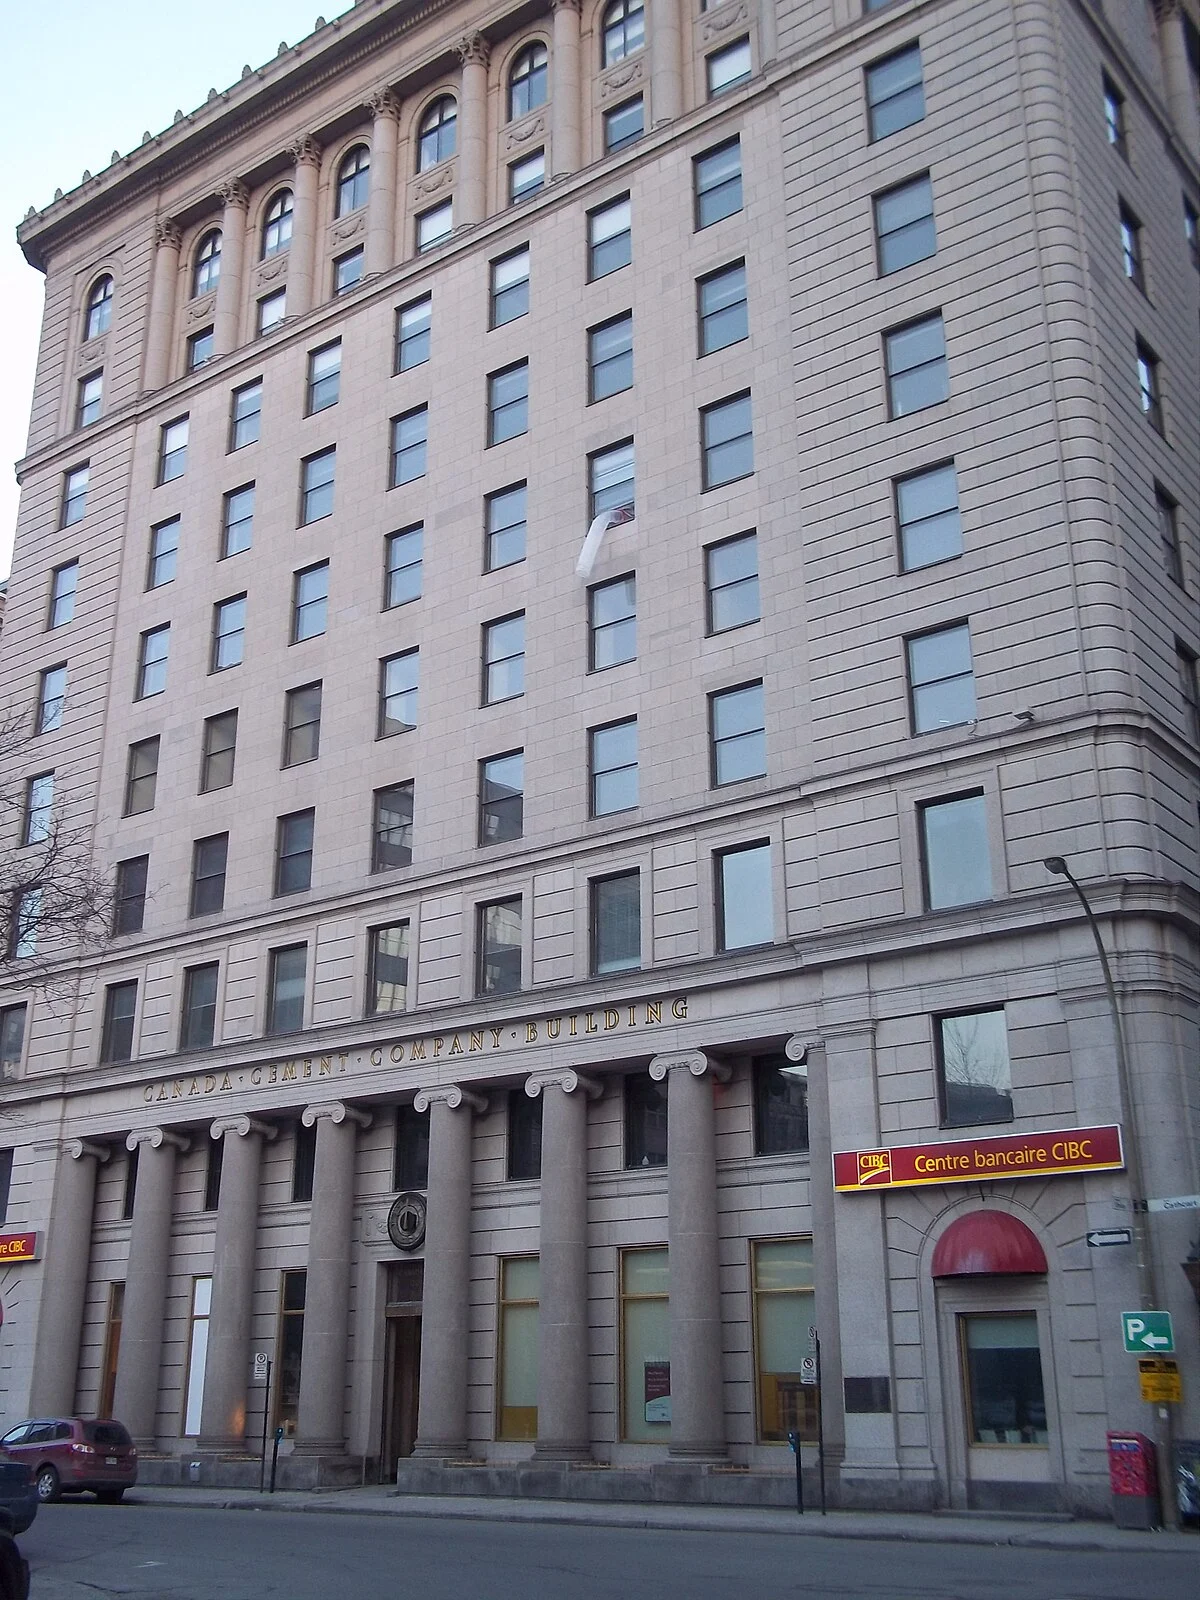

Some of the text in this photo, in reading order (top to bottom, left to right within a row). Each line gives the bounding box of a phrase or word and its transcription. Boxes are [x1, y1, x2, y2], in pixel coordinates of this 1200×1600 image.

[143, 997, 689, 1102] CANADA CEMENT COMPANY BUILDING
[859, 1152, 889, 1169] CIBC
[915, 1140, 1093, 1173] Centre bancaire CIBC
[8, 1240, 27, 1253] CIBC
[1127, 1318, 1145, 1341] P
